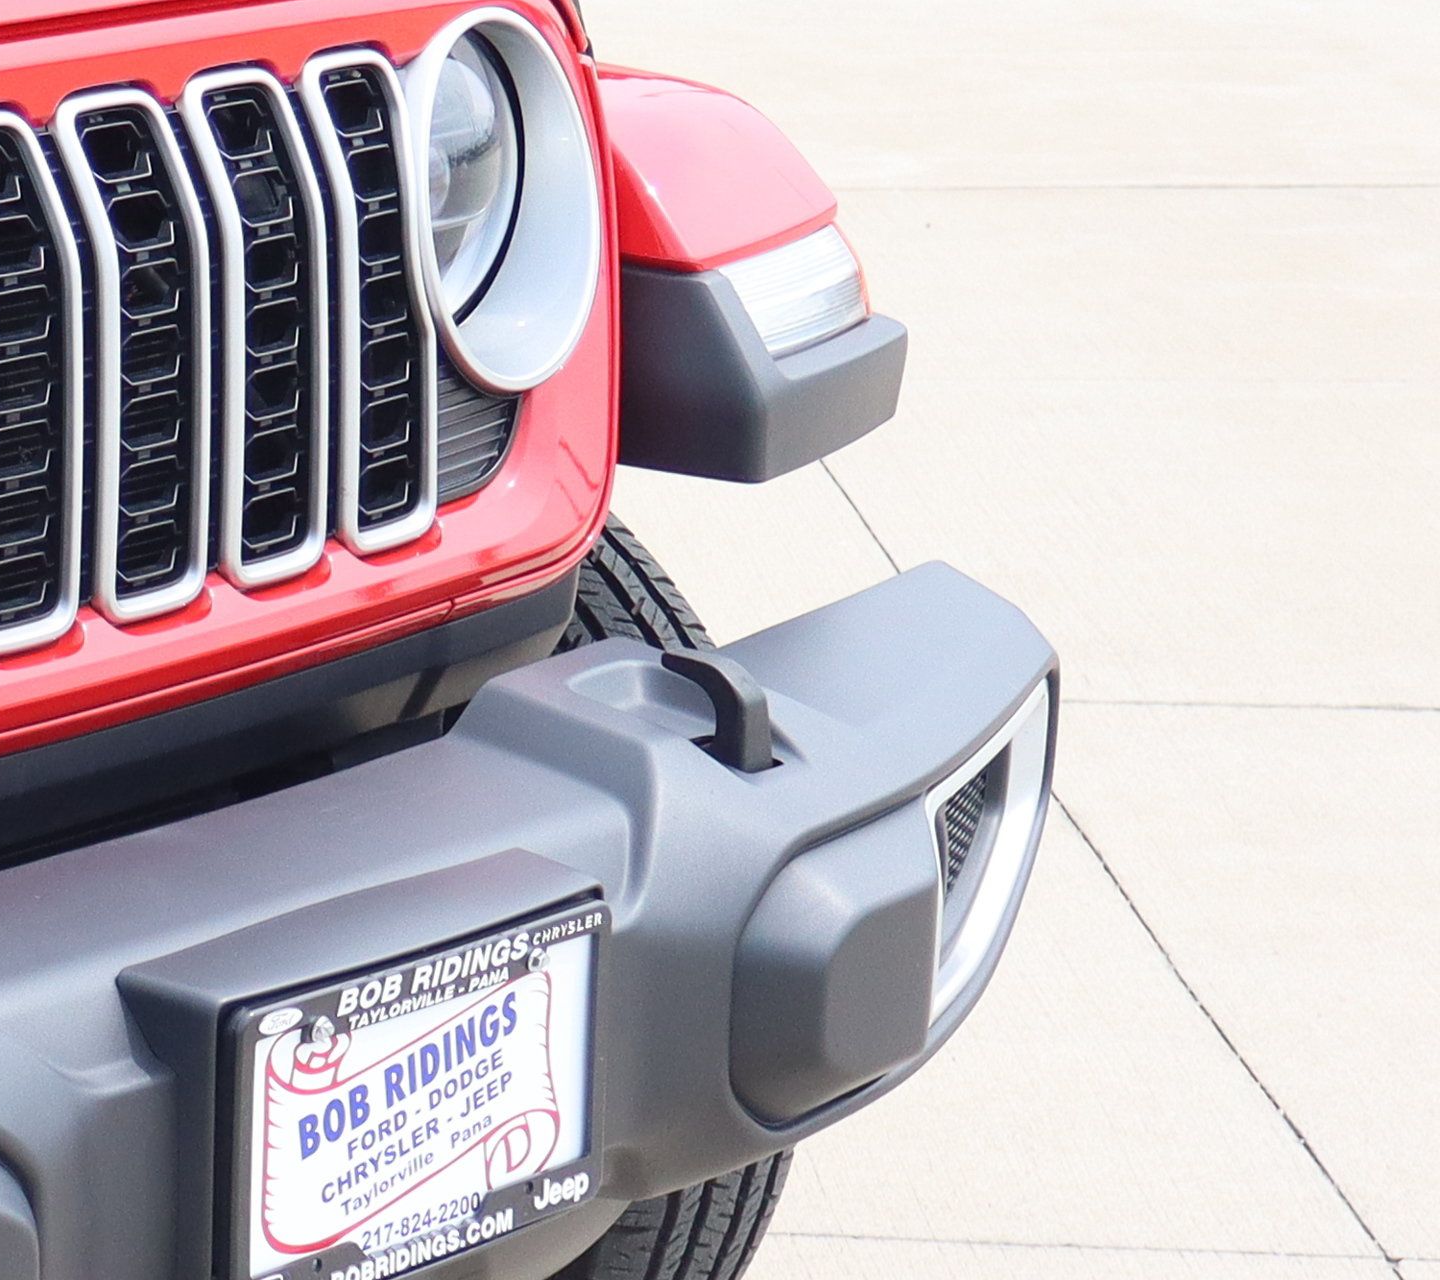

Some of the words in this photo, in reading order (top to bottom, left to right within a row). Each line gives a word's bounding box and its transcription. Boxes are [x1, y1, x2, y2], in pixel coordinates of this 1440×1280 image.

[533, 912, 602, 946] CHRYSLER
[336, 970, 402, 1018] BOB
[411, 932, 530, 995] RIDINGS
[348, 986, 454, 1031] TAYLORVILLE
[467, 967, 509, 993] PANA
[298, 1084, 370, 1160] BOB
[384, 991, 517, 1108] RIDINGS
[347, 1109, 407, 1160] FORD
[430, 1049, 504, 1111] DODGE
[321, 1117, 438, 1203] CHRYSLER
[460, 1072, 512, 1117] JEEP
[341, 1150, 435, 1216] Taylorville
[450, 1113, 494, 1149] Pana
[362, 1192, 480, 1251] 217-824-2200
[534, 1172, 589, 1210] Jeep
